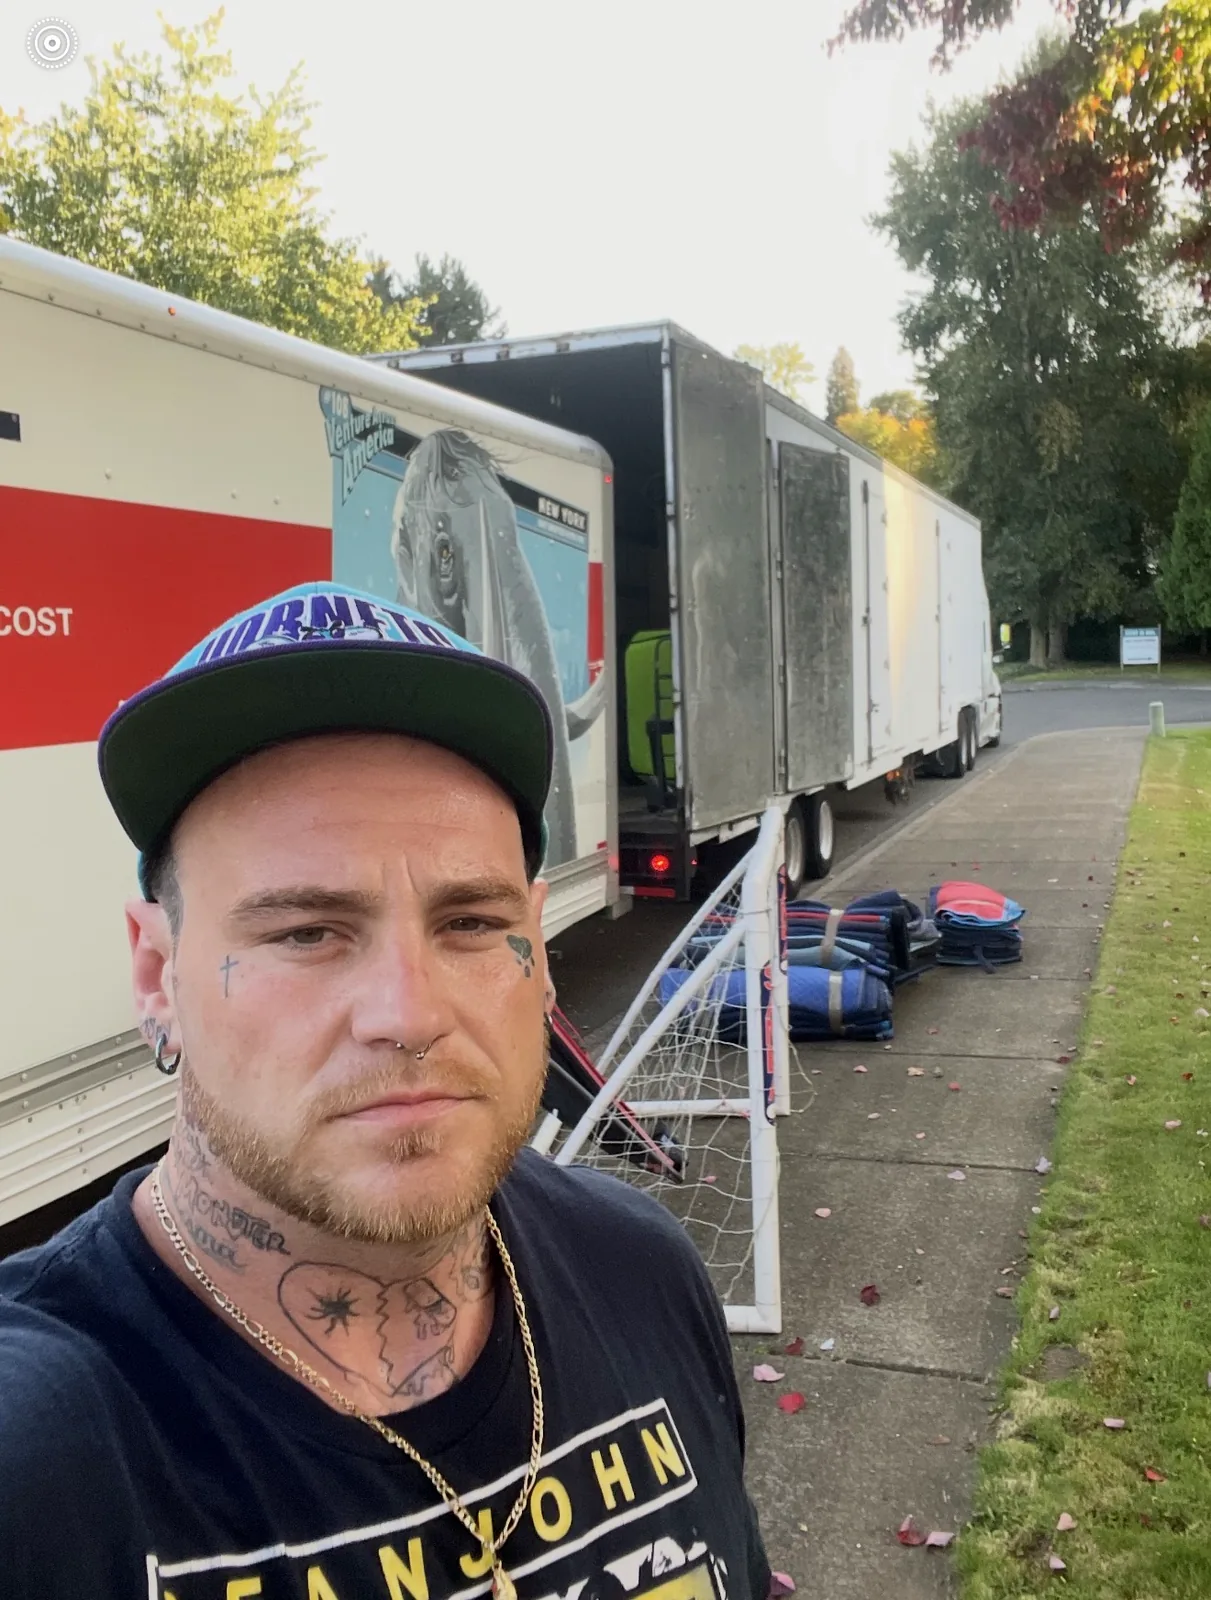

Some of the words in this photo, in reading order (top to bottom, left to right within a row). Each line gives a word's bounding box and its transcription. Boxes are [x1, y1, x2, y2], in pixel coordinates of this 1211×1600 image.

[325, 413, 371, 454] Venture
[342, 424, 395, 505] America
[538, 497, 560, 520] NEW
[561, 507, 586, 530] YORK
